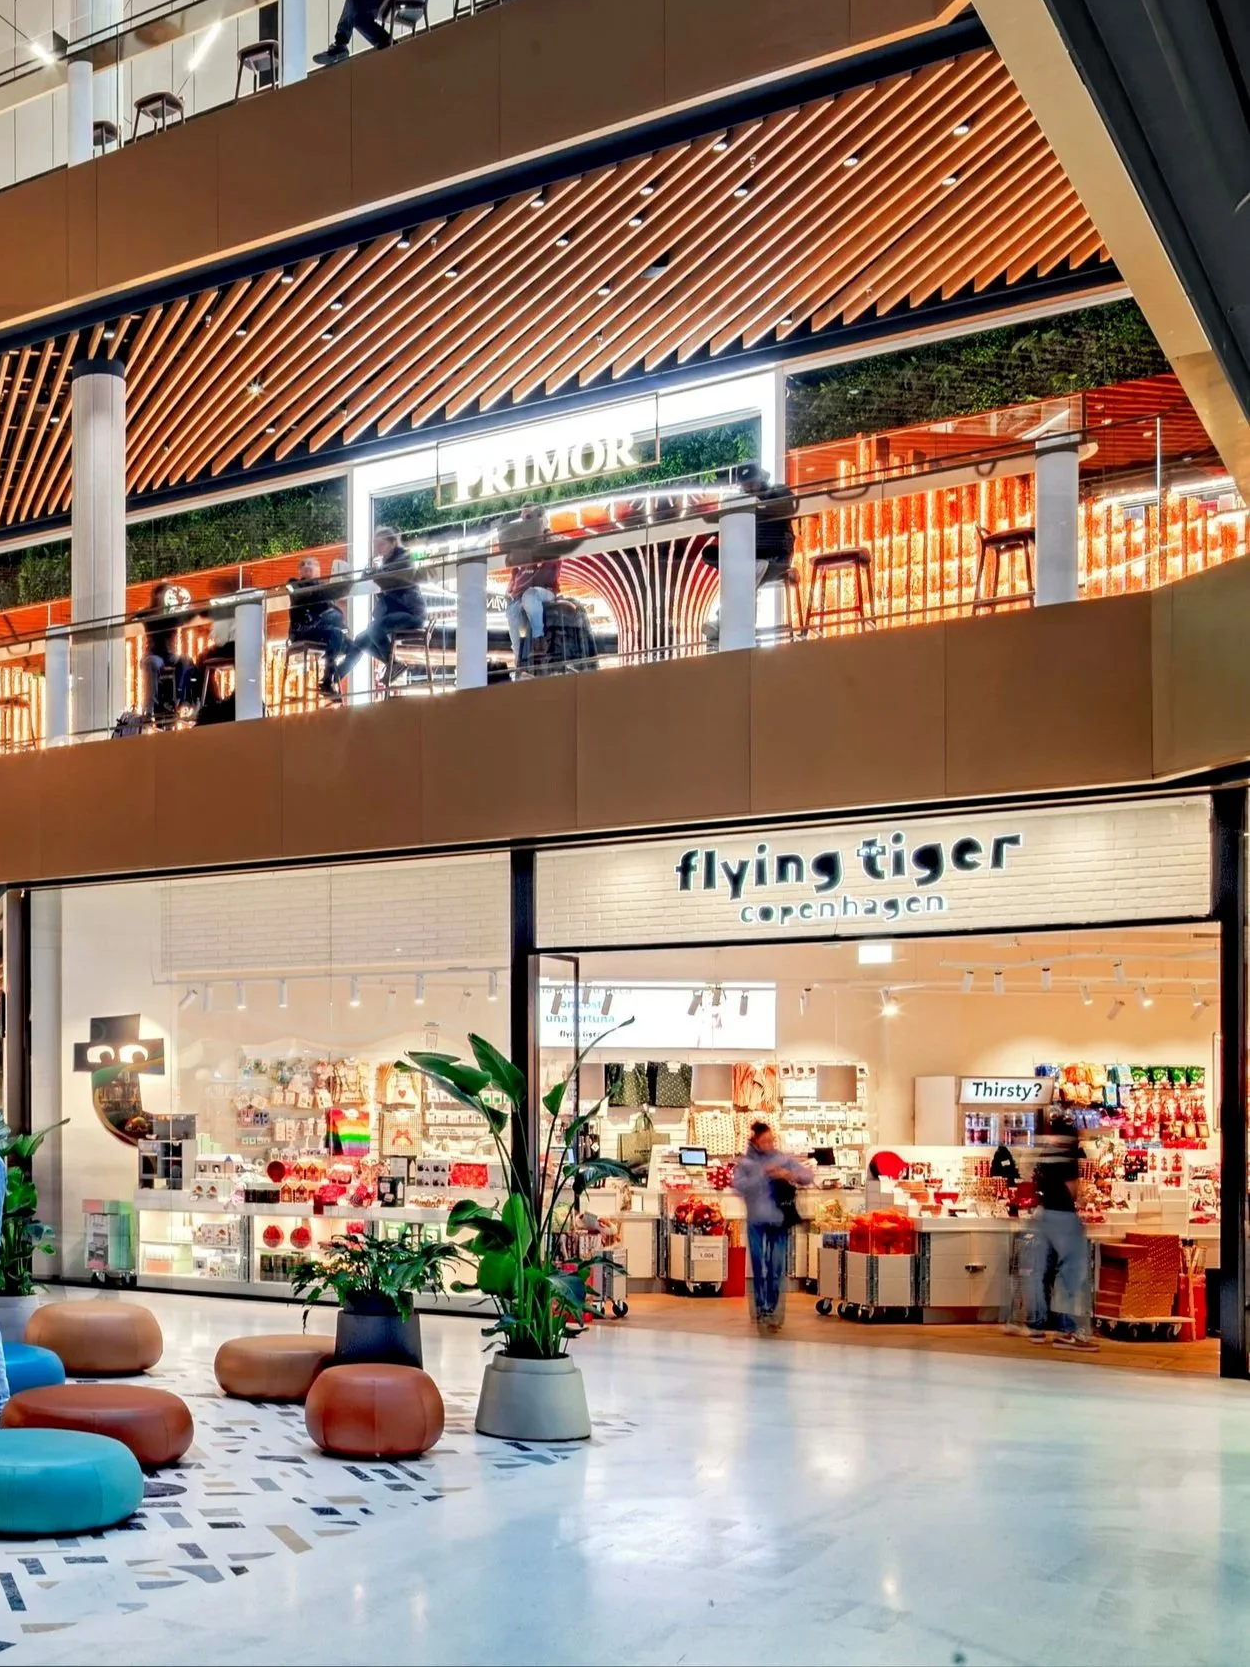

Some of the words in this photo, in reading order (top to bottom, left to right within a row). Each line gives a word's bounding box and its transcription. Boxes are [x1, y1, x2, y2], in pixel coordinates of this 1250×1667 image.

[454, 434, 638, 503] PRIMOR
[675, 843, 844, 900] flying
[857, 831, 1022, 888] tiger
[740, 895, 945, 924] copenhagen
[972, 1081, 1043, 1102] Thirsty?
